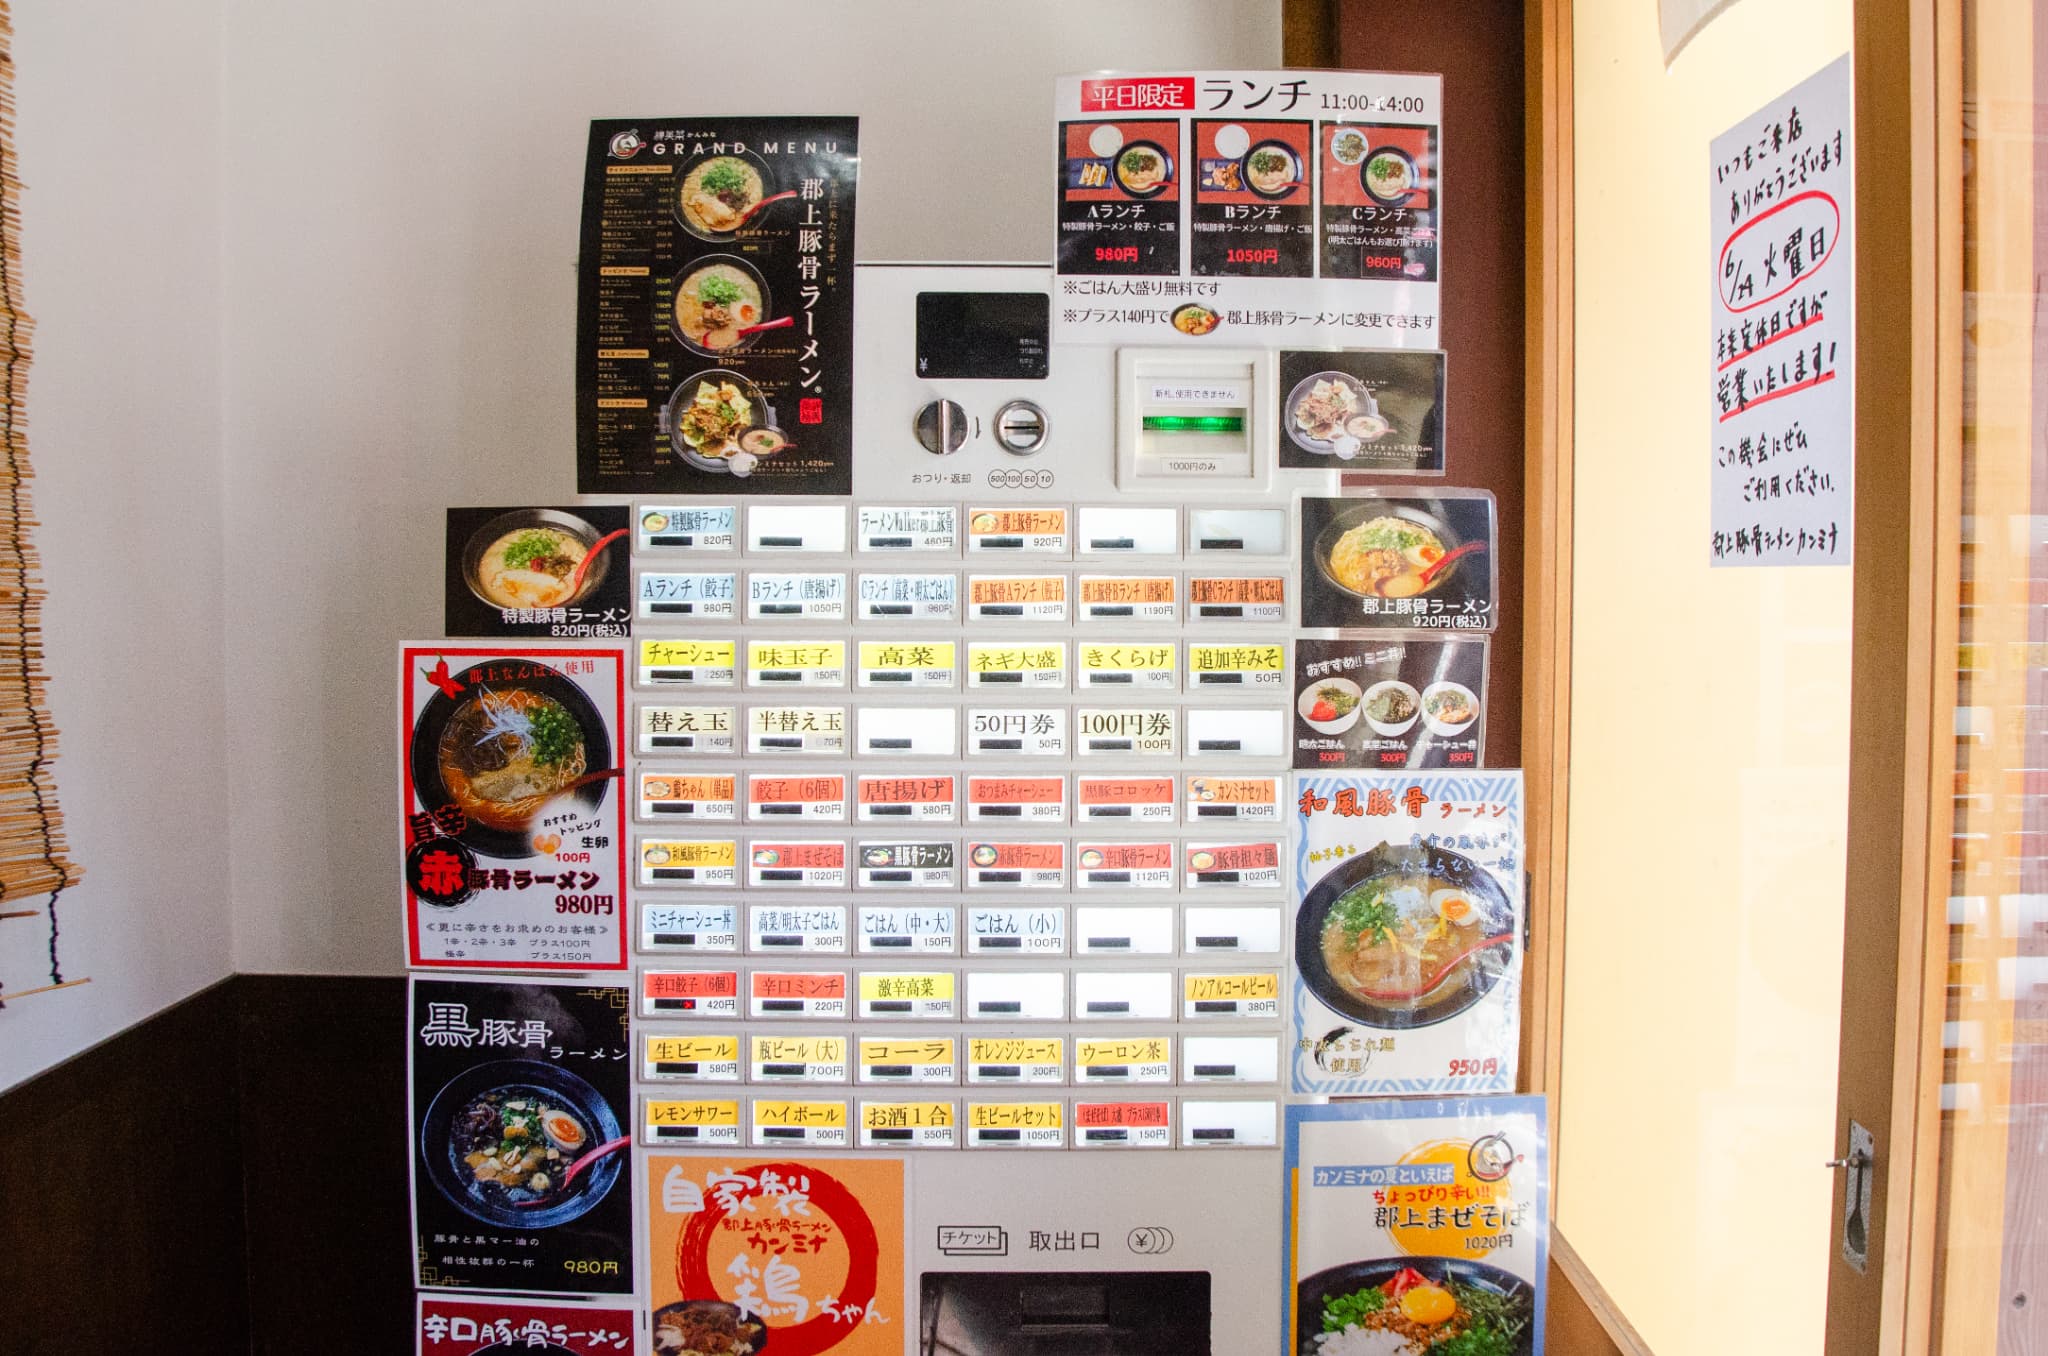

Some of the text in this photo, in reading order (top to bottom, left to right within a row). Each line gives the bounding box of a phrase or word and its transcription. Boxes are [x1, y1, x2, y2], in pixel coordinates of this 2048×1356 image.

[1091, 84, 1184, 109] 平日限定
[1202, 80, 1312, 112] ランチ
[653, 142, 838, 155] GRAND MENU
[1088, 204, 1145, 218] Aランチ
[1225, 205, 1281, 219] Bランチ
[1352, 207, 1407, 221] Cランチ
[1095, 248, 1138, 262] 980円
[1227, 249, 1278, 264] 1050円
[1764, 227, 1824, 287] 火曜日
[1366, 256, 1401, 269] 960円
[1064, 281, 1221, 296] ※ごはん大盛り無料です
[1064, 308, 1435, 330] ※プラス140円で 郡上豚骨ラーメンに変更できます
[1169, 463, 1216, 471] 1000円のみ
[912, 474, 971, 484] おつり・返却
[704, 535, 732, 544] 820円
[1034, 538, 1062, 547] 920円
[704, 604, 732, 612] 980円
[809, 604, 841, 613] 1050円
[1033, 605, 1063, 614] 1120円
[1362, 599, 1492, 614] 郡上豚骨ラーメン
[502, 608, 632, 624] 特製豚骨ラーメン
[1412, 616, 1488, 628] 920円(税込)
[552, 625, 627, 637] 820円(税込)
[649, 643, 729, 663] チャーシュー
[759, 648, 832, 666] 味玉子
[878, 647, 934, 666] 高菜
[1088, 649, 1168, 667] きくらげ
[1198, 649, 1279, 669] 追加辛みそ
[977, 651, 1056, 670] ネギ大盛
[815, 671, 838, 679] 150円
[924, 672, 946, 680] 150円
[1148, 672, 1169, 680] 100円
[1256, 673, 1281, 682] 50円
[648, 712, 728, 732] 替え玉
[758, 711, 842, 732] 半替え玉
[974, 713, 1055, 734] 50円券
[1080, 713, 1171, 736] 100円券
[710, 738, 732, 746] 140円
[1039, 740, 1061, 749] 50円
[1137, 740, 1171, 749] 100円
[1319, 752, 1345, 762] 300円
[1380, 753, 1407, 762] 300円
[865, 780, 946, 801] 唐揚げ
[1086, 784, 1166, 798] 黒豚コロッケ
[1218, 781, 1270, 801] カンミナセット
[706, 804, 733, 813] 650円
[813, 805, 841, 813] 420円
[923, 805, 951, 814] 580円
[1299, 787, 1508, 819] 和風豚骨 ラーメン
[1032, 806, 1060, 815] 380円
[1143, 807, 1171, 815] 250円
[1241, 806, 1274, 815] 1420円
[408, 803, 467, 842] 旨辛
[544, 813, 577, 827] おすすめ
[559, 818, 601, 835] トッピング
[582, 836, 609, 848] 生卵
[555, 853, 590, 863] 100円
[894, 847, 951, 866] 黒豚骨ラーメン
[419, 850, 600, 895] 赤 豚骨ラーメン
[706, 869, 733, 878] 950円
[809, 871, 842, 880] 1020円
[1037, 872, 1060, 881] 980円
[1136, 872, 1169, 881] 1120円
[1243, 871, 1277, 881] 1020円
[555, 895, 613, 914] 980円
[651, 910, 731, 929] ミニチャーシュー丼
[759, 912, 839, 931] 高菜/明太子ごはん
[529, 940, 591, 948] プラス100円
[707, 935, 734, 944] 350円
[815, 936, 842, 945] 300円
[924, 938, 951, 946] 150円
[1028, 939, 1060, 947] 100円
[531, 952, 592, 960] プラス150円
[763, 978, 839, 994] 辛口ミンチ
[878, 978, 934, 997] 激辛高菜
[1192, 977, 1274, 999] ノンアルコールビール
[707, 1000, 734, 1009] 420円
[815, 1001, 842, 1010] 220円
[1248, 1002, 1275, 1011] 380円
[421, 1002, 628, 1060] 黒豚骨 ラーメン
[656, 1041, 732, 1059] 生ビール
[868, 1043, 945, 1060] コーラ
[974, 1041, 1055, 1060] オレンジジュース
[1084, 1042, 1160, 1061] ウーロン茶
[710, 1064, 736, 1073] 580円
[810, 1066, 843, 1075] 700円
[923, 1067, 951, 1076] 300円
[1141, 1066, 1167, 1075] 250円
[1449, 1058, 1498, 1077] 950円
[655, 1106, 732, 1121] レモンサワー
[763, 1106, 839, 1122] ハイボール
[976, 1106, 1055, 1125] 生ビールセット
[710, 1128, 736, 1137] 500円
[817, 1130, 844, 1139] 500円
[925, 1130, 951, 1139] 550円
[1026, 1130, 1059, 1139] 1050円
[1140, 1129, 1165, 1139] 150円
[1316, 1167, 1453, 1185] カンミナの夏といえば
[662, 1164, 811, 1217] 自家製
[1375, 1202, 1530, 1229] 郡上まぜそば
[723, 1218, 832, 1233] 郡上豚骨ラーメン
[434, 1234, 539, 1247] 豚骨と黒マー油の
[748, 1233, 828, 1255] カンミナ
[943, 1230, 997, 1249] チケット
[1029, 1230, 1099, 1251] 取出口
[1465, 1234, 1512, 1249] 1020円
[442, 1256, 535, 1267] 相性抜群の一杯
[564, 1260, 619, 1275] 980円
[424, 1314, 629, 1349] 辛口豚骨ラーメン
